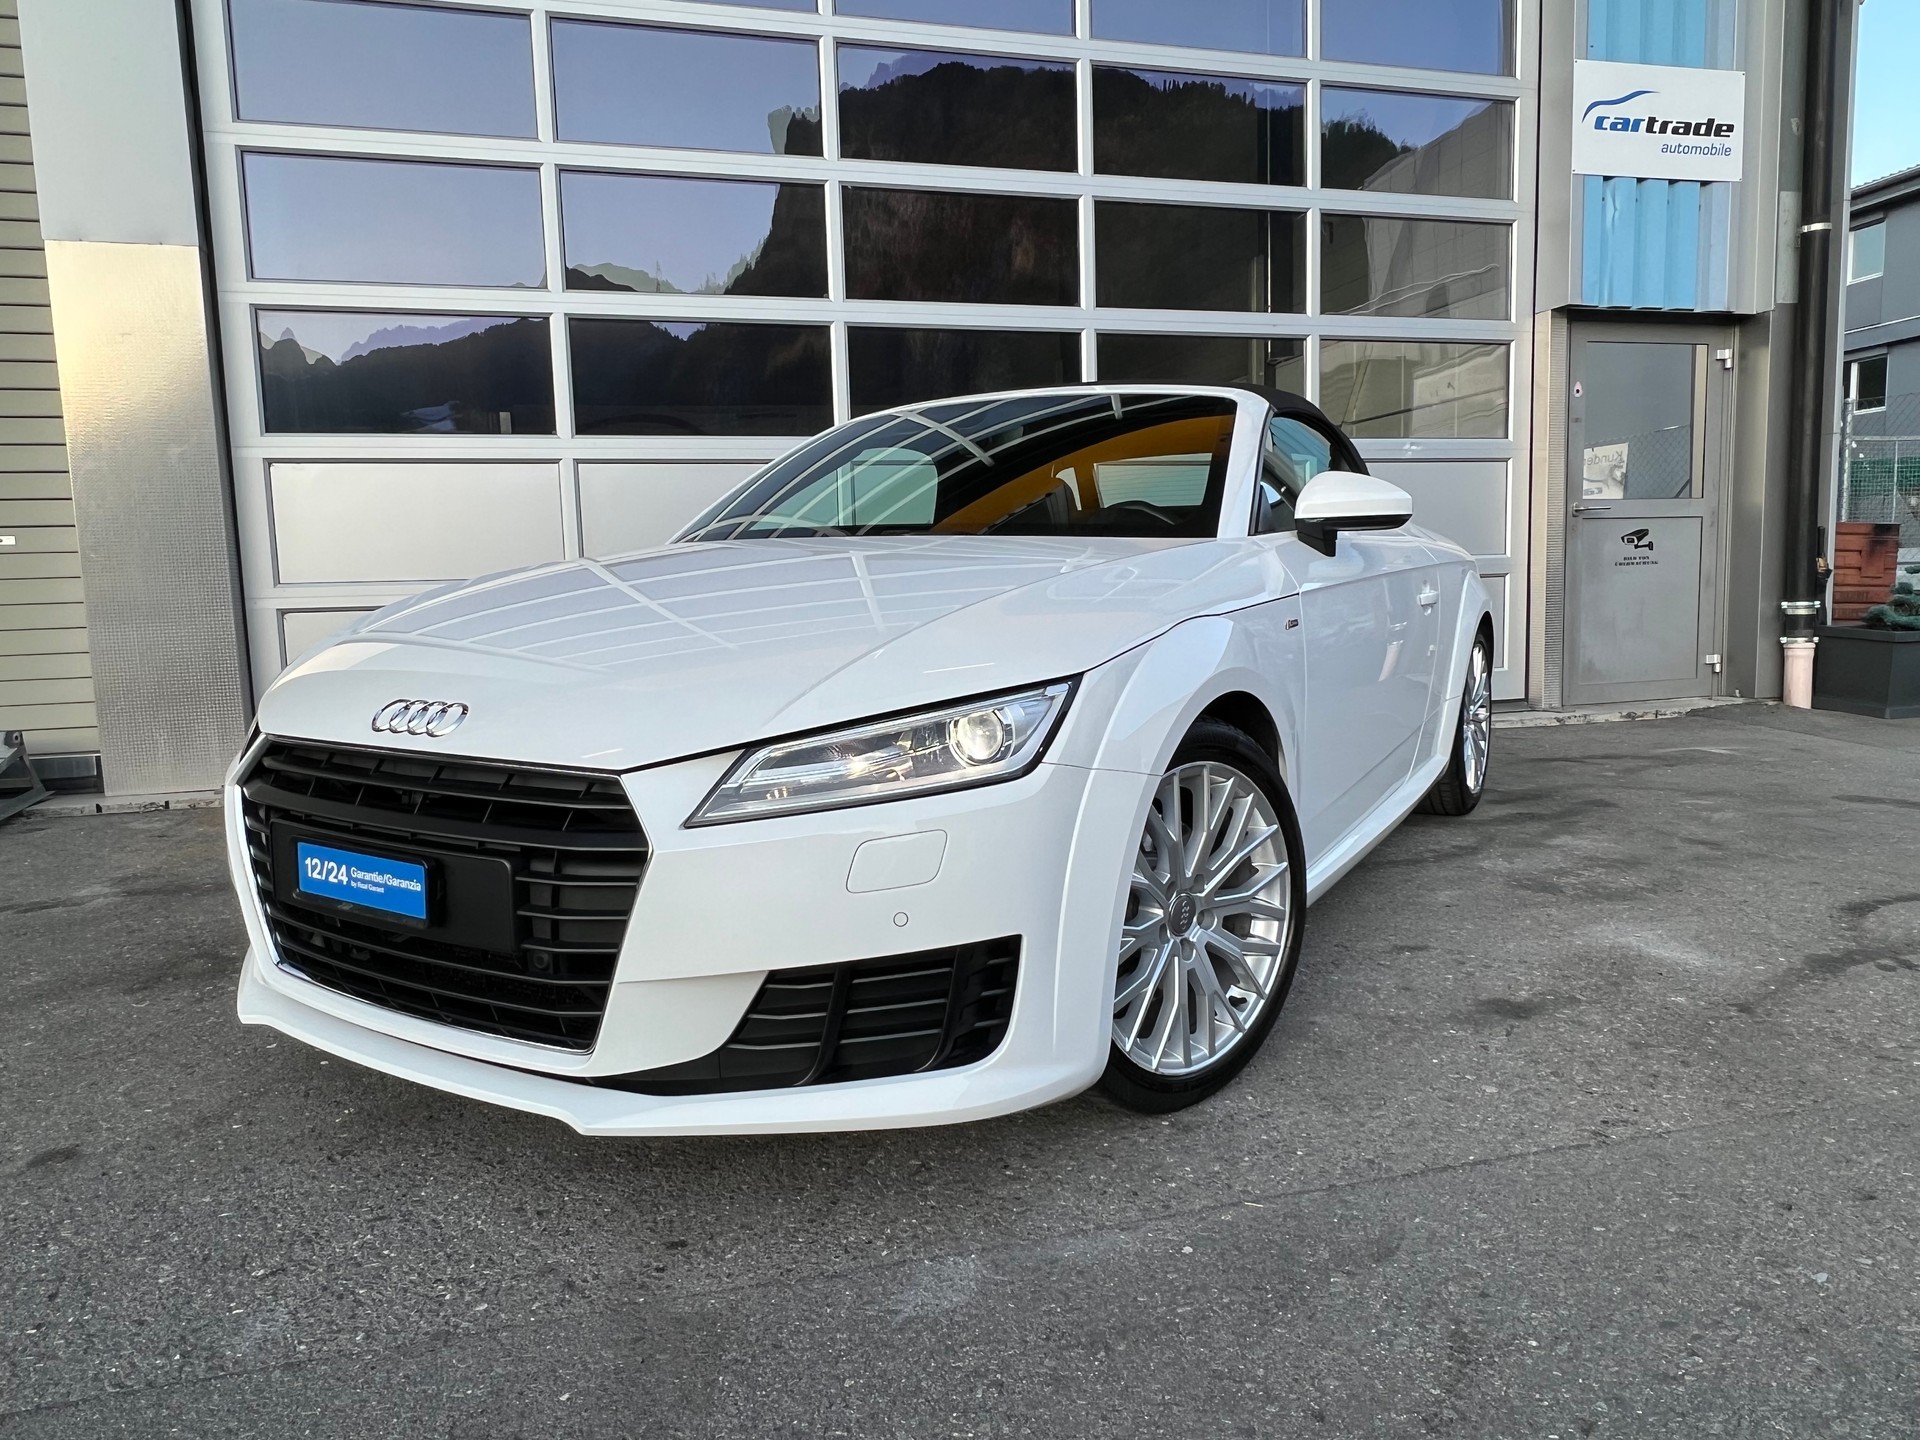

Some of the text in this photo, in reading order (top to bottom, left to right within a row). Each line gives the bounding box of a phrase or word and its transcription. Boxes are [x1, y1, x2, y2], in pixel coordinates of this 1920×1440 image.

[1594, 116, 1735, 137] cartrade
[1661, 143, 1732, 157] automobile
[304, 857, 422, 892] 12/24 Garantie/Garanzia
